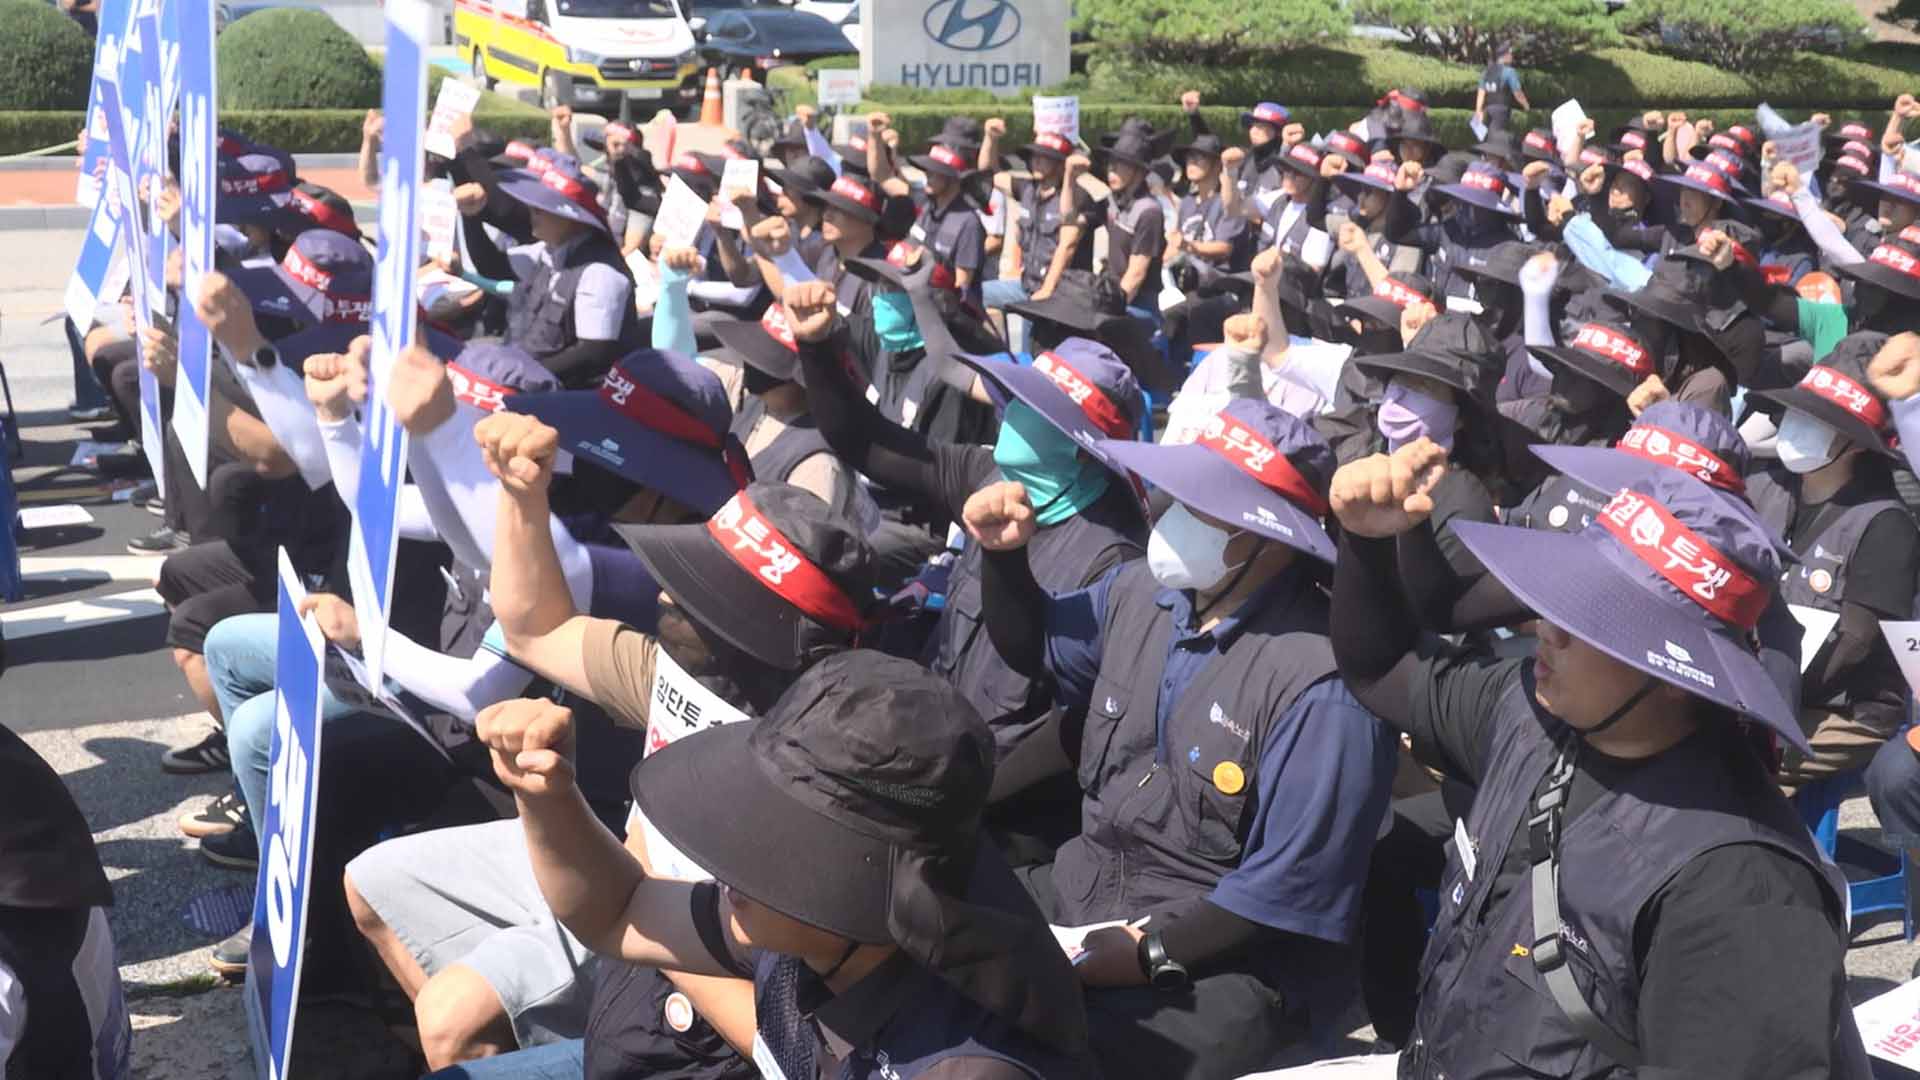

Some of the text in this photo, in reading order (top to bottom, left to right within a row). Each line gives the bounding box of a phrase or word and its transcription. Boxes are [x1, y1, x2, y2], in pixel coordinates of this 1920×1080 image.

[901, 63, 1042, 88] HYUNDAI
[602, 367, 636, 406] 투쟁
[1047, 366, 1093, 405] 투쟁
[1831, 379, 1872, 413] 투쟁
[1221, 425, 1276, 473] 투쟁
[1670, 443, 1721, 482] 투쟁
[734, 516, 801, 586] 투쟁
[1661, 534, 1732, 601] 투쟁
[656, 675, 702, 728] 임단투
[267, 687, 308, 969] 쟁
